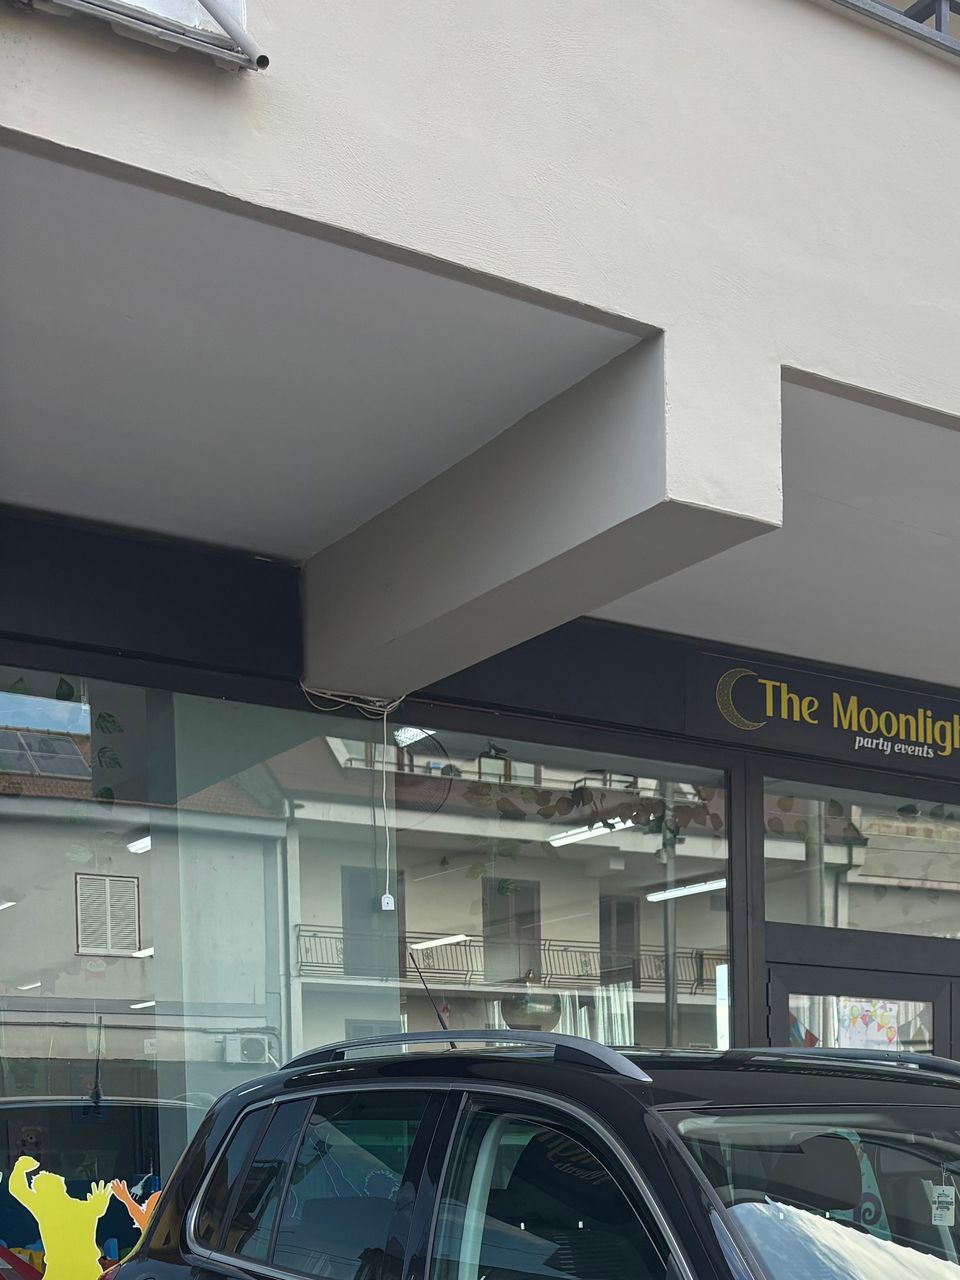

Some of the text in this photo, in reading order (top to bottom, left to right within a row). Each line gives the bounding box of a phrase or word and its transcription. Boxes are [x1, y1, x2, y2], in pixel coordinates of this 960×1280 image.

[758, 678, 819, 725] The
[854, 734, 935, 758] party events
